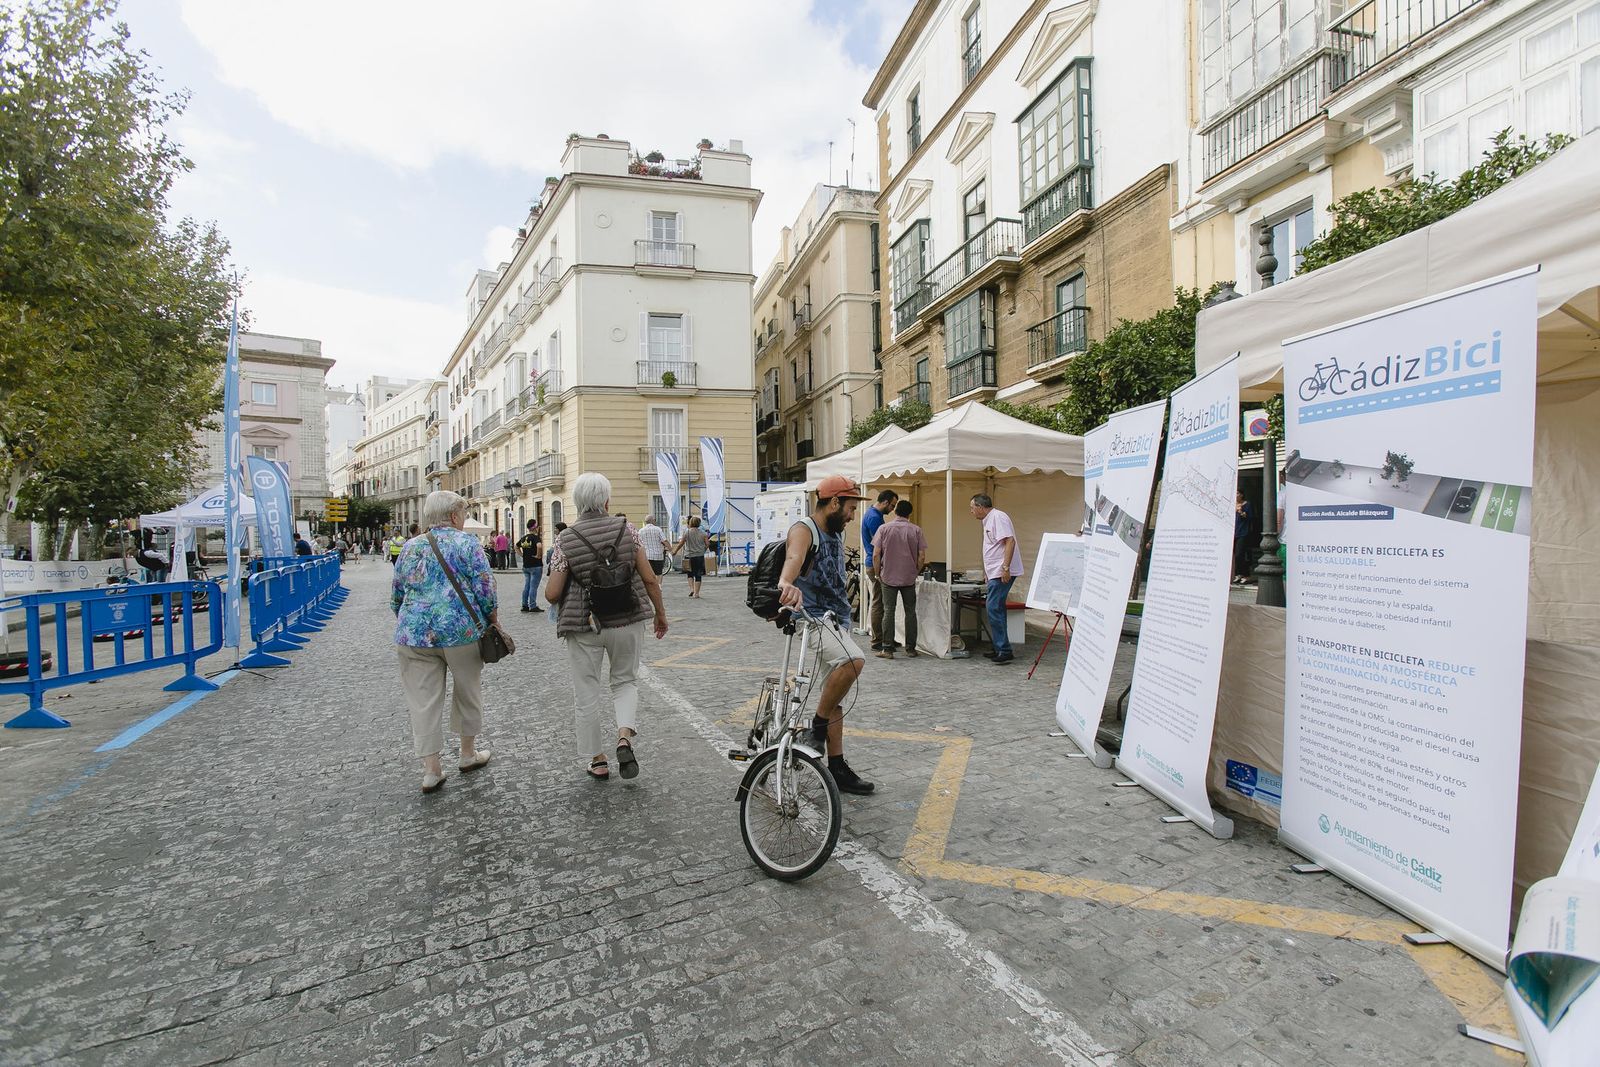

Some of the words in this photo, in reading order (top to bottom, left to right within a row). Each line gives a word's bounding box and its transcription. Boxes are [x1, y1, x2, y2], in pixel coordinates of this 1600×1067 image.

[1298, 544, 1305, 553] EL
[1307, 544, 1358, 555] TRANSPORTE
[1361, 546, 1373, 556] EN
[1376, 547, 1429, 558] BICICLETA
[1432, 549, 1445, 558] ES
[1324, 557, 1377, 567] SALUDABLE.
[1306, 570, 1326, 579] Porque
[1327, 571, 1349, 580] mejora
[1358, 573, 1417, 586] funcionamiento
[1419, 577, 1431, 586] del
[1433, 579, 1469, 589] sistema
[1333, 583, 1337, 591] y
[1345, 584, 1371, 593] sistema
[1306, 591, 1328, 601] Protege
[1329, 593, 1337, 601] las
[1339, 595, 1385, 606] articulaciones
[1387, 601, 1392, 609] y
[1394, 600, 1400, 608] la
[1306, 602, 1330, 612] Previene
[1376, 611, 1382, 619] la
[1384, 613, 1420, 624] obesidad
[1422, 617, 1452, 628] infantil
[1339, 617, 1347, 625] de
[1349, 618, 1354, 626] la
[1298, 635, 1305, 643] EL
[1306, 637, 1358, 655] TRANSPORTE
[1360, 647, 1372, 657] EN
[1374, 649, 1425, 667] BICICLETA
[1428, 659, 1477, 677] REDUCE
[1298, 645, 1306, 654] LA
[1382, 663, 1458, 687] ATMOSFÉRICA
[1303, 658, 1312, 666] LA
[1301, 681, 1320, 692] Europa
[1321, 687, 1331, 695] por
[1332, 689, 1338, 698] la
[1337, 681, 1365, 694] muertes
[1366, 688, 1409, 705] prematuras
[1410, 698, 1417, 707] al
[1419, 701, 1435, 712] año
[1437, 706, 1448, 715] en
[1311, 707, 1355, 724] especialmente
[1356, 719, 1362, 727] la
[1363, 723, 1399, 739] producida
[1400, 733, 1414, 744] por
[1416, 738, 1423, 746] el
[1425, 740, 1450, 755] diesel
[1451, 749, 1480, 763] causa
[1323, 700, 1349, 713] estudios
[1350, 707, 1359, 716] de
[1360, 710, 1366, 718] la
[1388, 718, 1395, 727] la
[1396, 720, 1457, 744] contaminación
[1459, 737, 1475, 749] del
[1328, 723, 1336, 731] de
[1337, 726, 1362, 739] pulmón
[1363, 734, 1367, 743] y
[1369, 736, 1377, 745] de
[1301, 735, 1330, 752] problemas
[1331, 746, 1339, 755] de
[1360, 757, 1366, 765] el
[1384, 765, 1395, 776] del
[1396, 770, 1415, 784] nivel
[1417, 777, 1442, 793] medio
[1445, 787, 1457, 798] de
[1305, 726, 1311, 734] La
[1312, 729, 1357, 750] contaminación
[1386, 756, 1408, 769] causa
[1410, 763, 1434, 778] estrés
[1436, 772, 1441, 782] y
[1443, 774, 1467, 789] otros
[1317, 752, 1337, 765] debido
[1376, 774, 1385, 783] de
[1260, 776, 1281, 788] FEDE
[1304, 777, 1323, 791] niveles
[1324, 787, 1340, 798] altos
[1340, 793, 1349, 802] de
[1318, 761, 1323, 770] la
[1324, 764, 1343, 777] OCDE
[1343, 772, 1366, 788] España
[1368, 783, 1375, 791] es
[1377, 785, 1384, 794] el
[1385, 790, 1418, 808] segundo
[1420, 803, 1436, 816] país
[1437, 810, 1451, 822] del
[1301, 766, 1320, 778] mundo
[1320, 773, 1332, 783] con
[1368, 794, 1377, 803] de
[1377, 799, 1412, 819] personas
[1413, 814, 1450, 834] expuesta
[1334, 820, 1394, 859] Ayuntamiento
[1396, 851, 1409, 867] de
[1410, 857, 1442, 884] Cádiz
